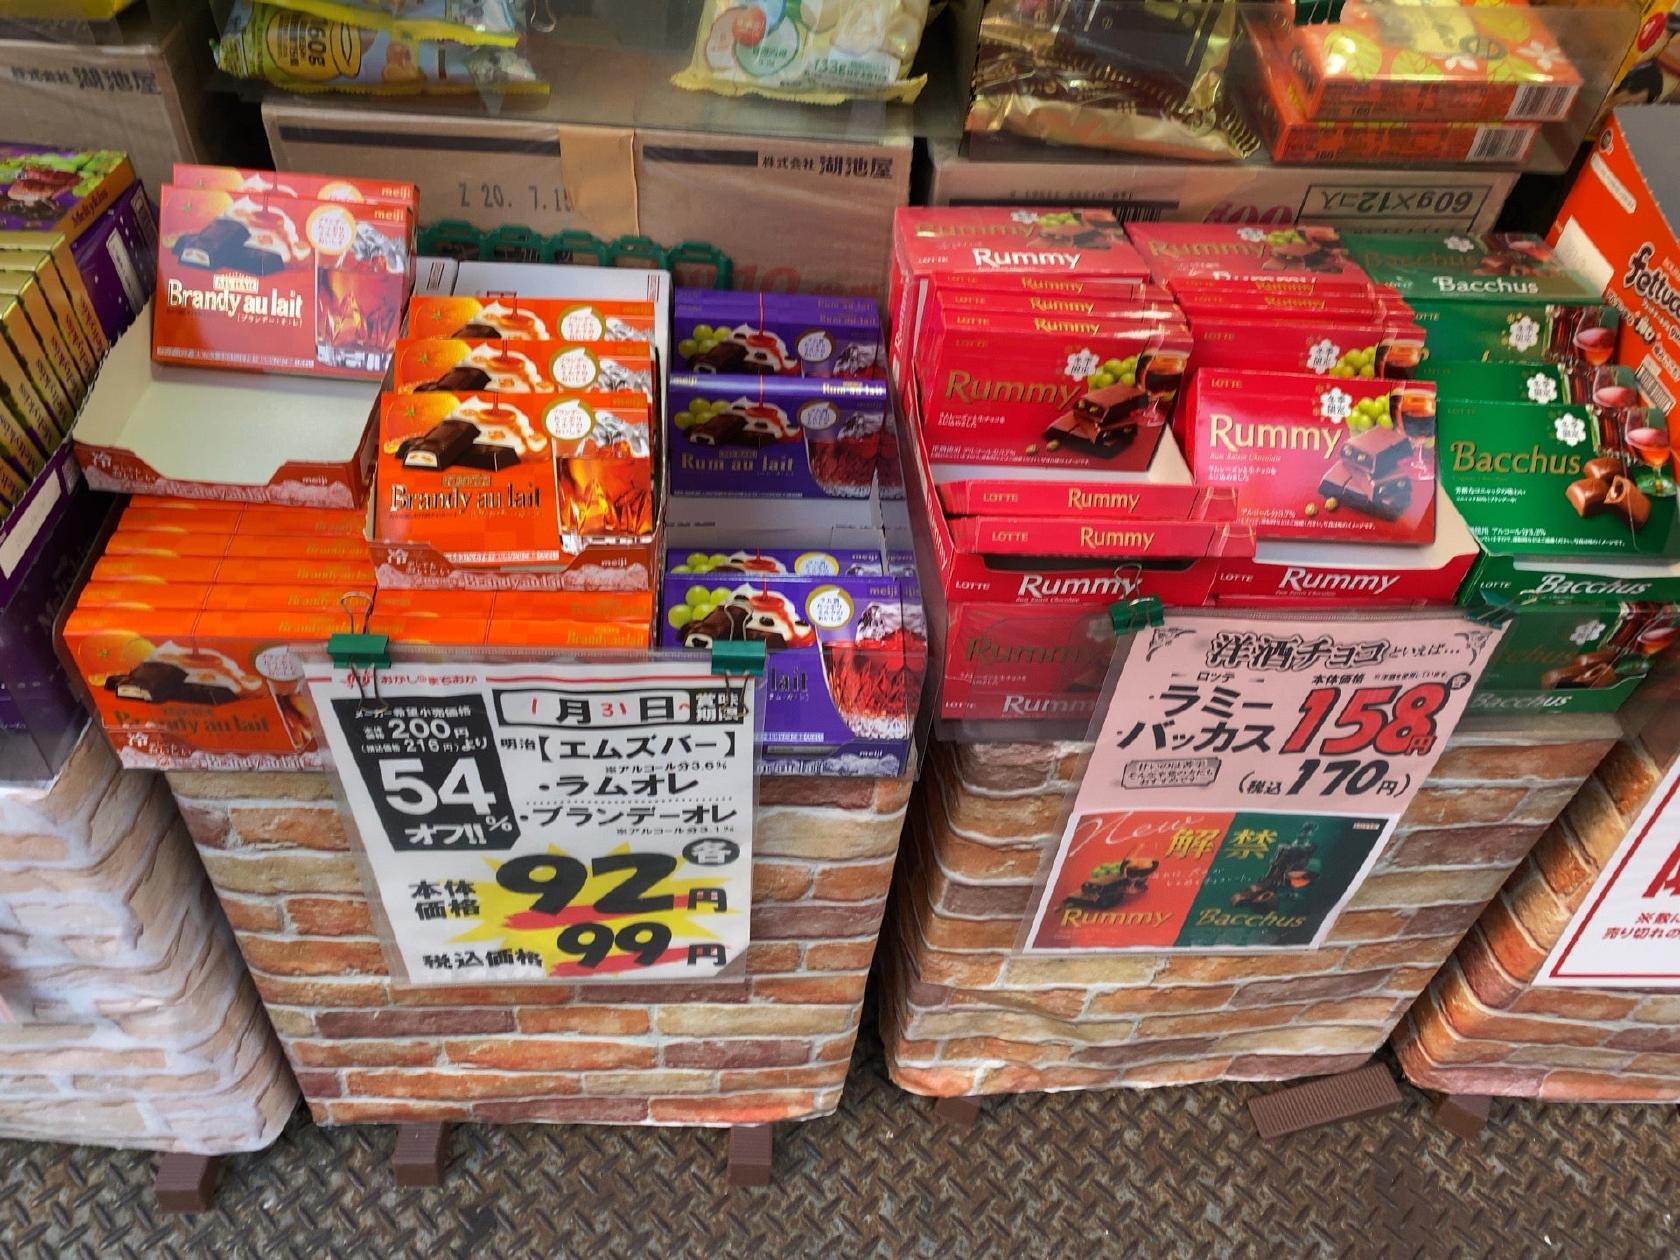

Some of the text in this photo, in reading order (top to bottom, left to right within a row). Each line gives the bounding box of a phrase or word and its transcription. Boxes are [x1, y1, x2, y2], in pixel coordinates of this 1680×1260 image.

[762, 156, 894, 180] 株式会社 湖池屋
[381, 186, 411, 199] meiji
[374, 208, 405, 221] meiji
[972, 248, 1083, 269] Rummy
[1021, 277, 1085, 295] Rummy
[1432, 275, 1540, 295] Bacchus
[168, 278, 303, 319] Brandy au lait
[954, 296, 1095, 315] LOTTE Rummy
[956, 317, 1100, 335] LOTTE Rummy
[1203, 332, 1236, 341] LOTTE
[822, 383, 846, 396] Rum
[945, 368, 1082, 411] Rummy
[1211, 378, 1243, 389] LOTTE
[1209, 413, 1343, 460] Rummy
[681, 453, 794, 473] Rum au lait
[1450, 441, 1584, 476] Bacchus
[302, 475, 328, 485] meiji
[390, 484, 541, 515] Brandy au lait
[983, 487, 1142, 512] LOTTE Rummy
[991, 525, 1155, 551] LOTTE Rummy
[601, 560, 628, 569] meiji
[851, 552, 878, 562] meiji
[955, 574, 1143, 600] LOTTE Rummy
[1220, 566, 1401, 594] LOTTE Rummy
[1480, 574, 1653, 595] LOTTE Bacchus
[869, 585, 898, 599] meiji
[1207, 631, 1391, 672] 洋酒チョコ
[770, 667, 808, 693] lait
[1197, 671, 1236, 684] ロッテ
[1312, 673, 1365, 685] 本体価格
[500, 737, 536, 751] 明治
[859, 749, 884, 759] meiji
[378, 757, 497, 816] 54
[408, 879, 477, 900] 本体
[414, 899, 481, 921] 価格
[1060, 907, 1308, 929] Rummy Bacchus
[421, 947, 543, 970] 税込価格
